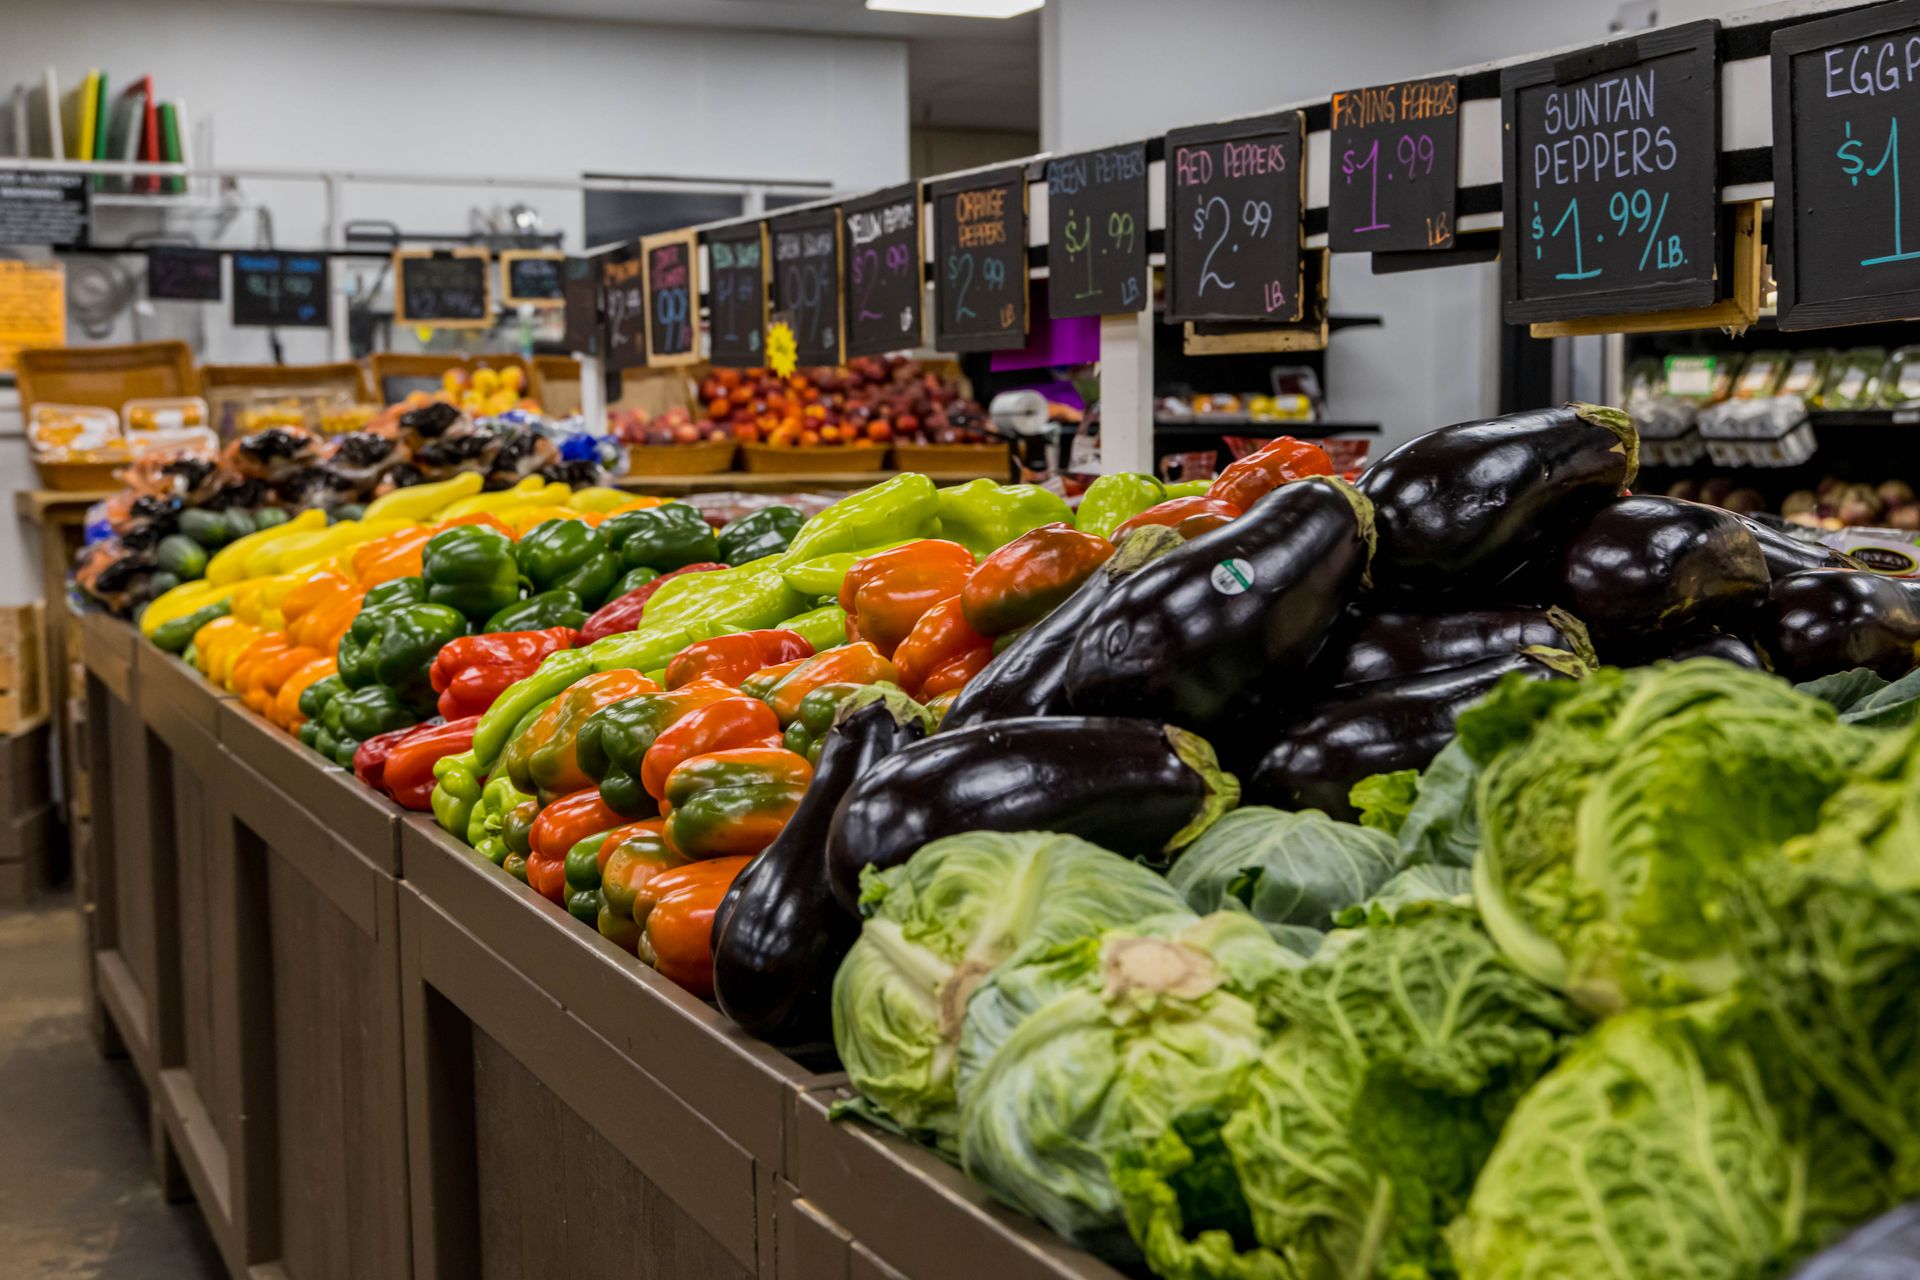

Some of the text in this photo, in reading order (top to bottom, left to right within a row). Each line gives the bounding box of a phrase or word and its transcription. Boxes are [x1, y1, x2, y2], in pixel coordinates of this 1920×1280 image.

[1332, 80, 1456, 130] FRYING PEPPERS
[1545, 69, 1654, 134] SUNTAN
[1096, 152, 1145, 184] PEPPERS
[1177, 142, 1286, 186] RED PEPPERS
[1342, 134, 1434, 233] $1.99
[1534, 126, 1677, 188] PEPPERS
[956, 188, 1007, 223] ORANGE
[1065, 209, 1134, 299] $1.99
[1193, 195, 1272, 296] $2.99
